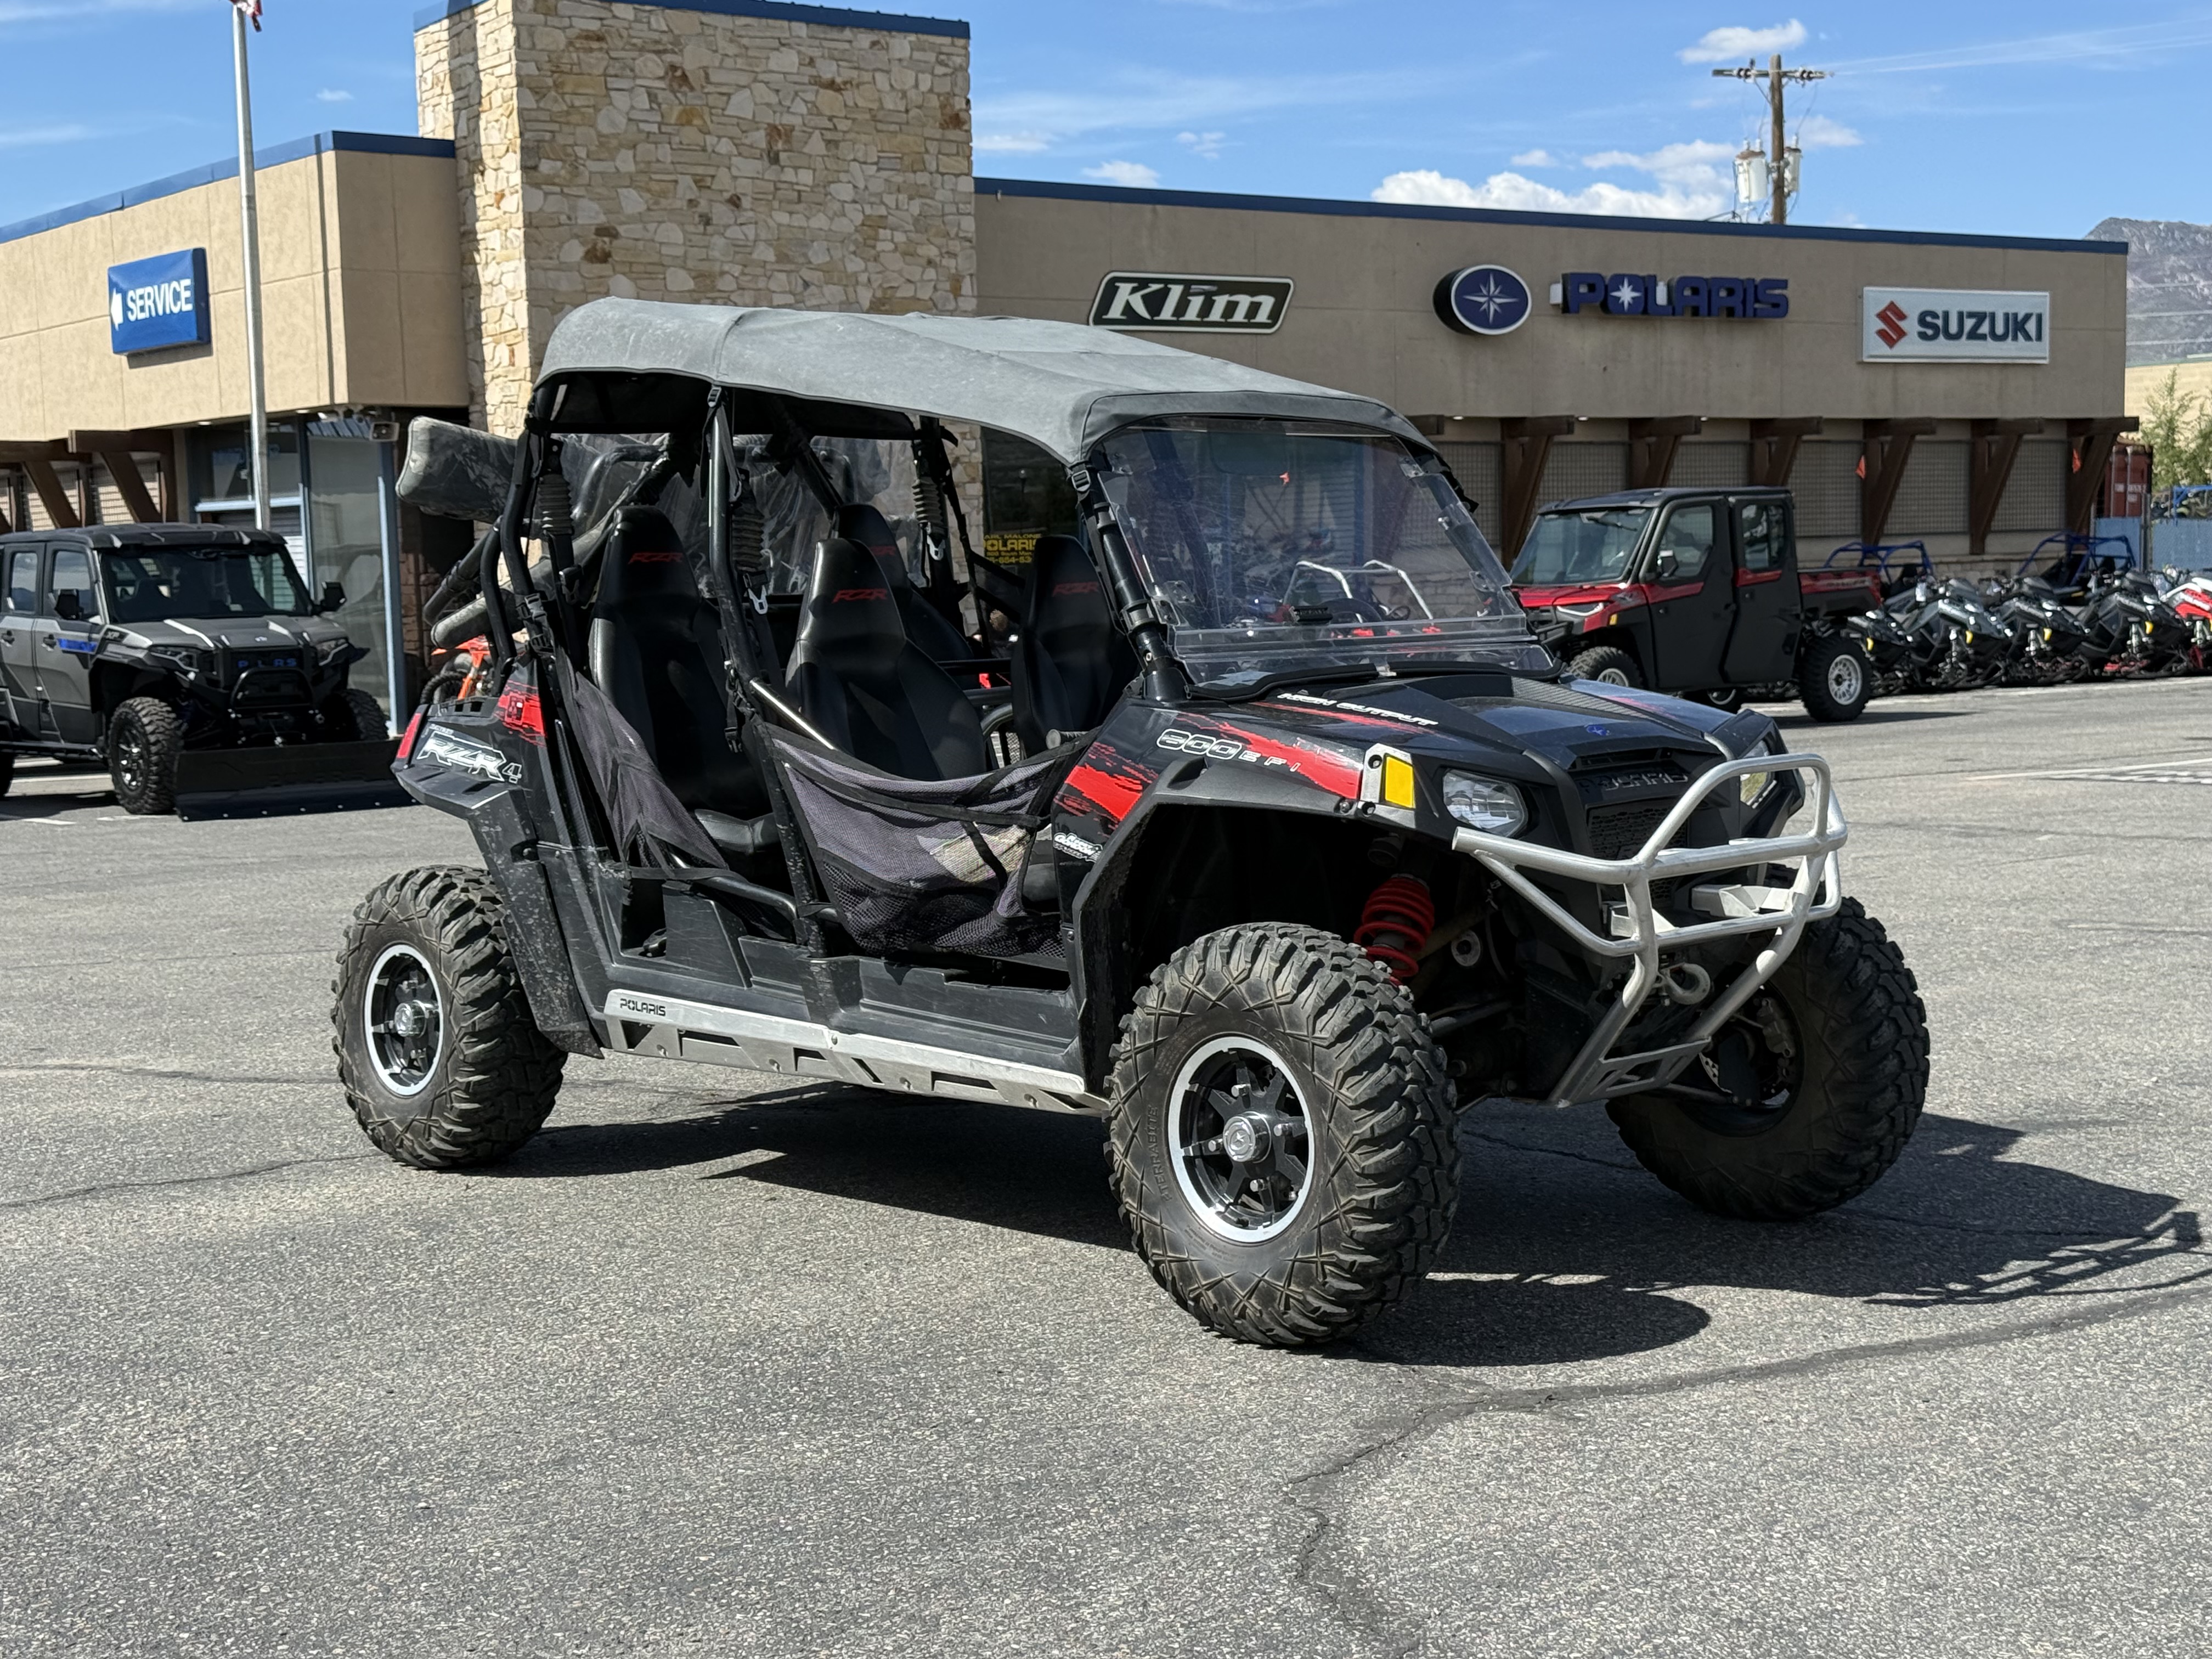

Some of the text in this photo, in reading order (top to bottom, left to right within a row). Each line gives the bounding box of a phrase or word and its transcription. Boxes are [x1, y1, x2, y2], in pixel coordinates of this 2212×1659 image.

[127, 278, 193, 321] SERVICE
[1564, 272, 1788, 318] POLARIS
[1917, 309, 2043, 342] SUZUKI
[983, 539, 1037, 551] OLARI
[1277, 693, 1438, 726] HIGH OUTPUT
[1156, 729, 1243, 760] 800
[502, 763, 522, 784] 4
[620, 998, 666, 1017] POLARIS
